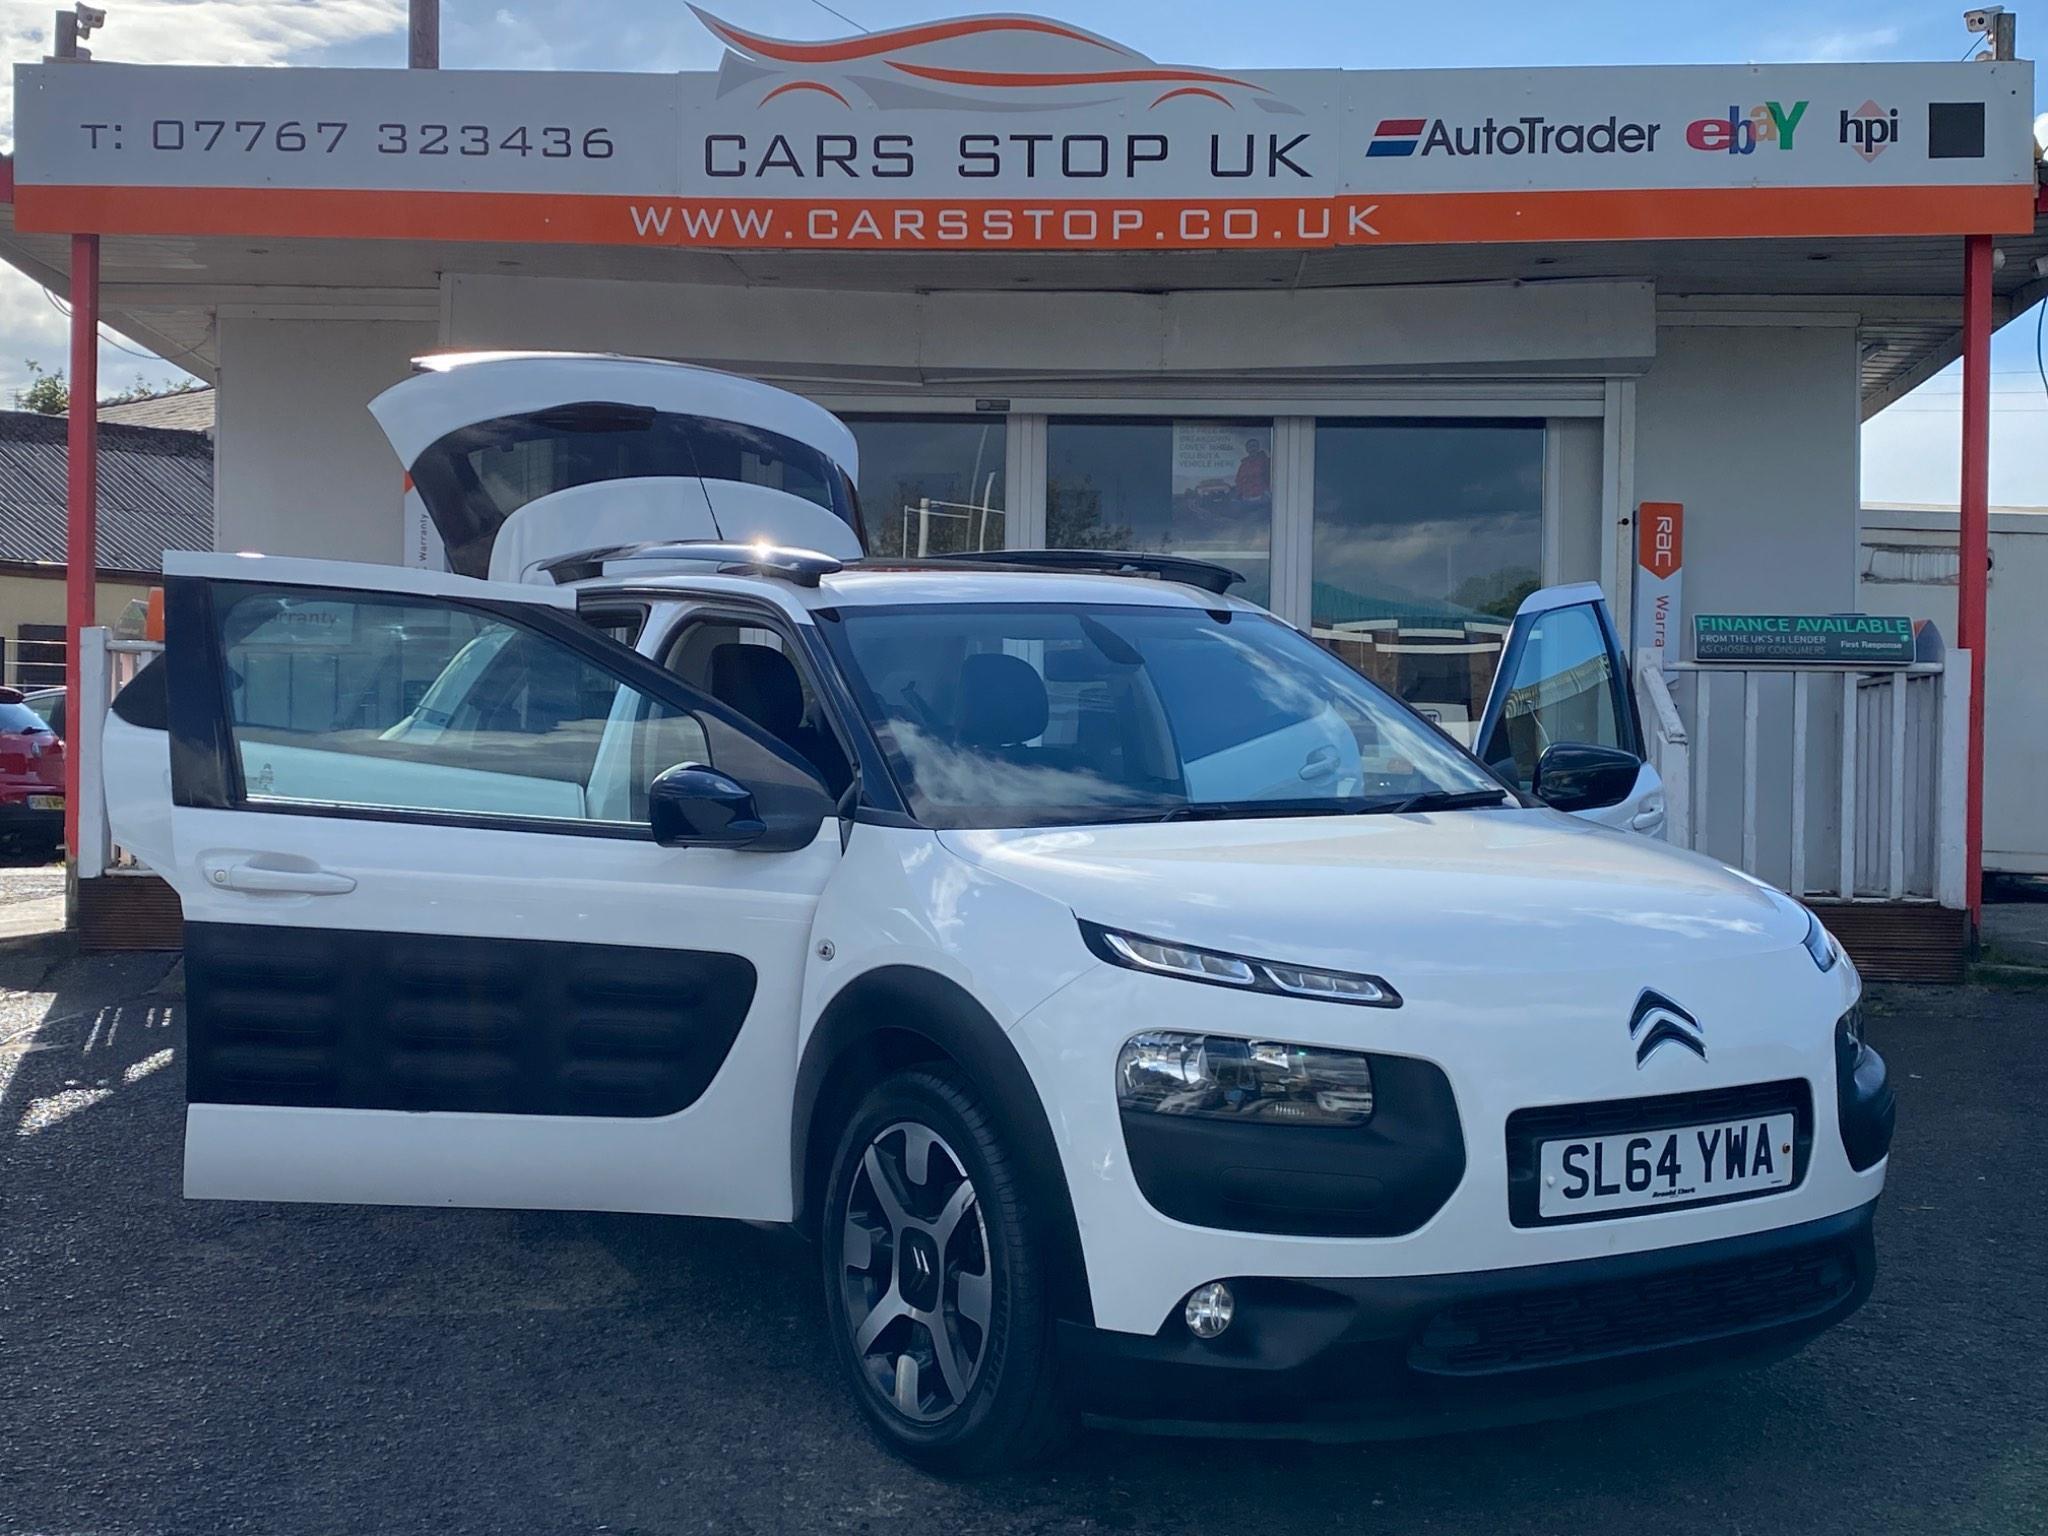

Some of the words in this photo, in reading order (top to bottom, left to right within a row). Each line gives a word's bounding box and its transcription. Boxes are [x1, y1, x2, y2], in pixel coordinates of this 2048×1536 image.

[152, 120, 348, 154] 07767
[378, 124, 614, 160] 323436
[1422, 116, 1661, 156] AutoTrader
[1840, 107, 1899, 153] hpi
[704, 133, 915, 178] CARS
[957, 133, 1168, 178] STOP
[1210, 133, 1313, 178] UK
[629, 204, 1381, 242] WWW.CARSSTOP.CO.UK
[418, 513, 429, 562] Warranty
[1654, 595, 1670, 648] Warra
[1699, 616, 1791, 633] FINANCE
[1796, 618, 1909, 634] AVAILABLE
[1700, 634, 1727, 643] FROM
[1729, 635, 1749, 643] THE
[1750, 635, 1773, 643] UK'S
[1788, 635, 1827, 644] LENDER
[1700, 645, 1712, 653] AS
[1713, 645, 1753, 654] CHOSEN
[1755, 645, 1766, 654] BY
[1767, 646, 1826, 655] CONSUMERS
[1840, 640, 1858, 649] First
[1861, 641, 1902, 650] Response
[1562, 1133, 1682, 1200] SL64
[1696, 1123, 1774, 1184] YWA
